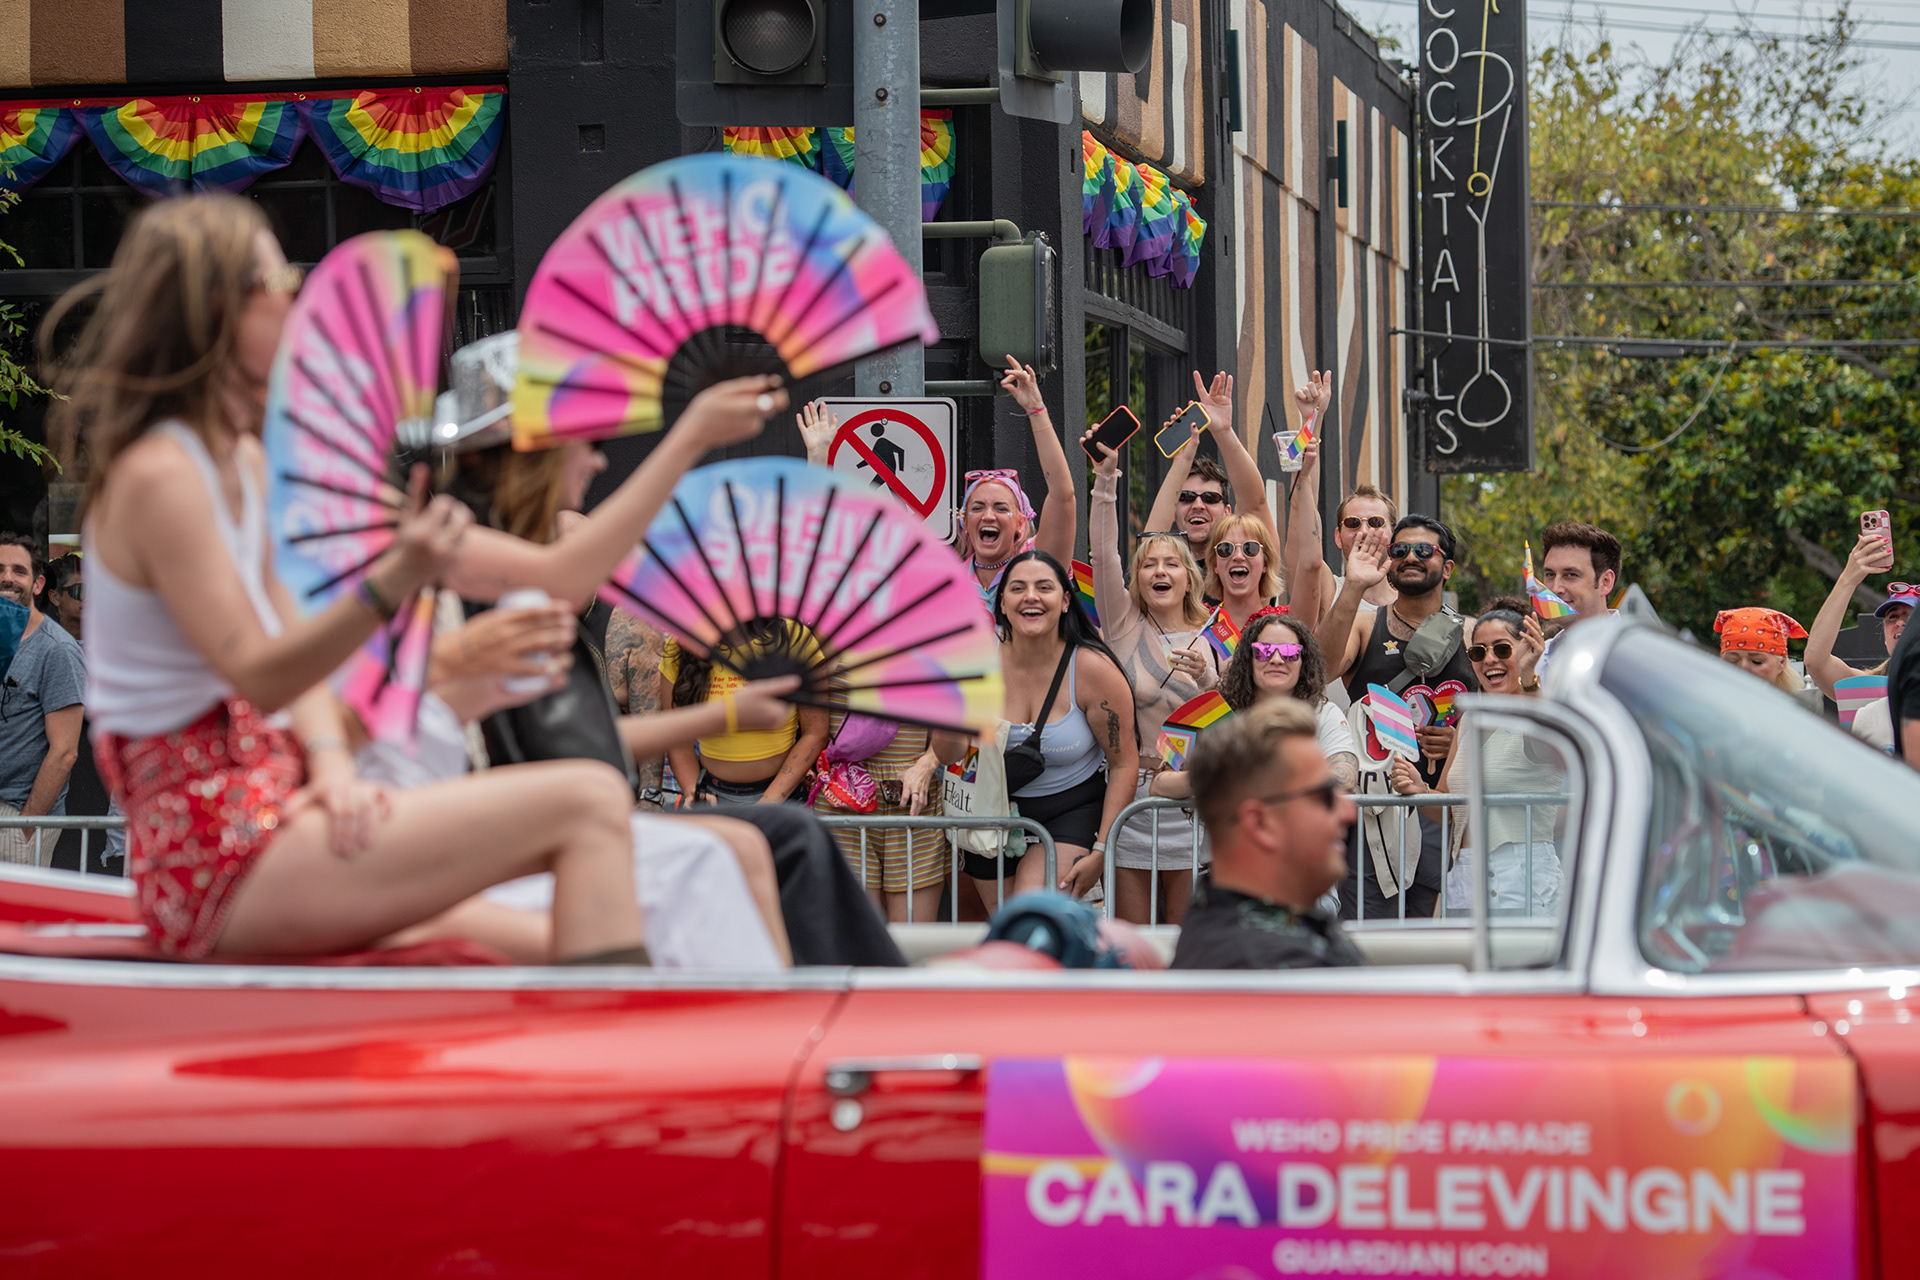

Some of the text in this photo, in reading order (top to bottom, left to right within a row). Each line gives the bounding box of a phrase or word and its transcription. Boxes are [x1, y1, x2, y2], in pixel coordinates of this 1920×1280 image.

[602, 179, 788, 268] WEHO
[612, 247, 797, 325] PRIDE
[1411, 688, 1433, 697] COUNTY
[1435, 684, 1451, 695] LOVES
[1452, 684, 1463, 692] YOU
[944, 779, 973, 815] Healt
[1231, 1118, 1592, 1155] WEHO PRIDE PARADE
[1026, 1161, 1805, 1236] CARA DELEVINGNE
[1272, 1238, 1549, 1278] GUARDIAN ICON
